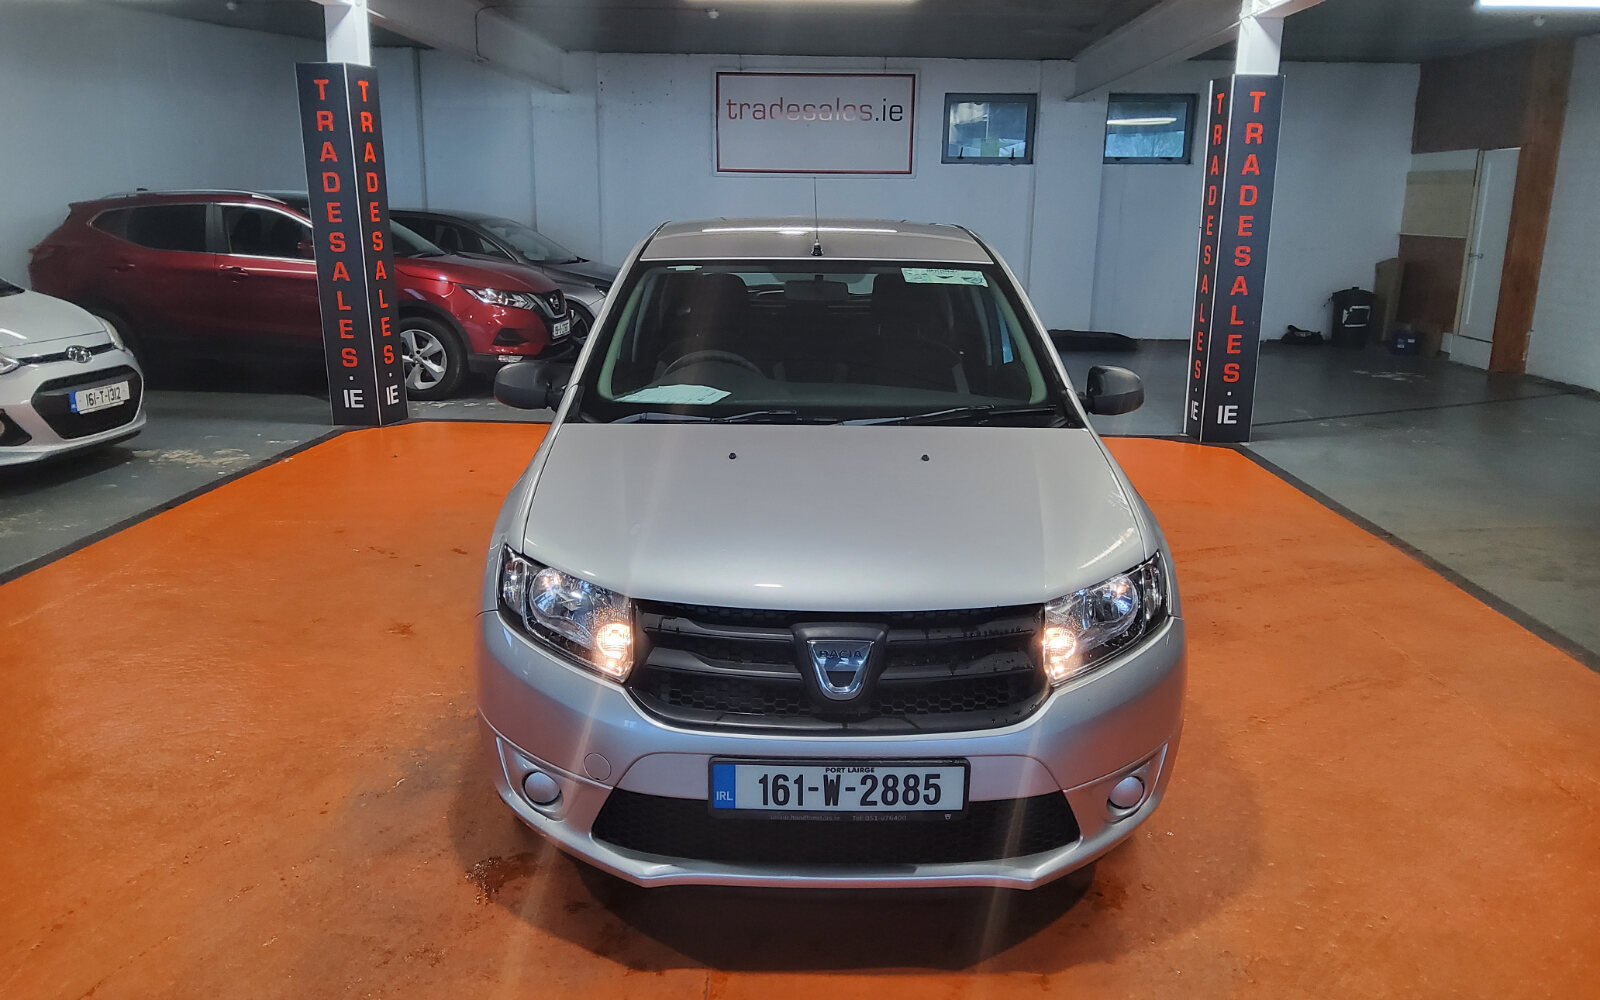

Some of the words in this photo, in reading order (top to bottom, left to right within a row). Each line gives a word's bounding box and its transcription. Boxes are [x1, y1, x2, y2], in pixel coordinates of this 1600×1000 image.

[85, 387, 121, 406] 161-T-1312
[820, 651, 862, 659] DACIA
[716, 791, 733, 800] IRL
[758, 773, 942, 806] 161-W-2885
